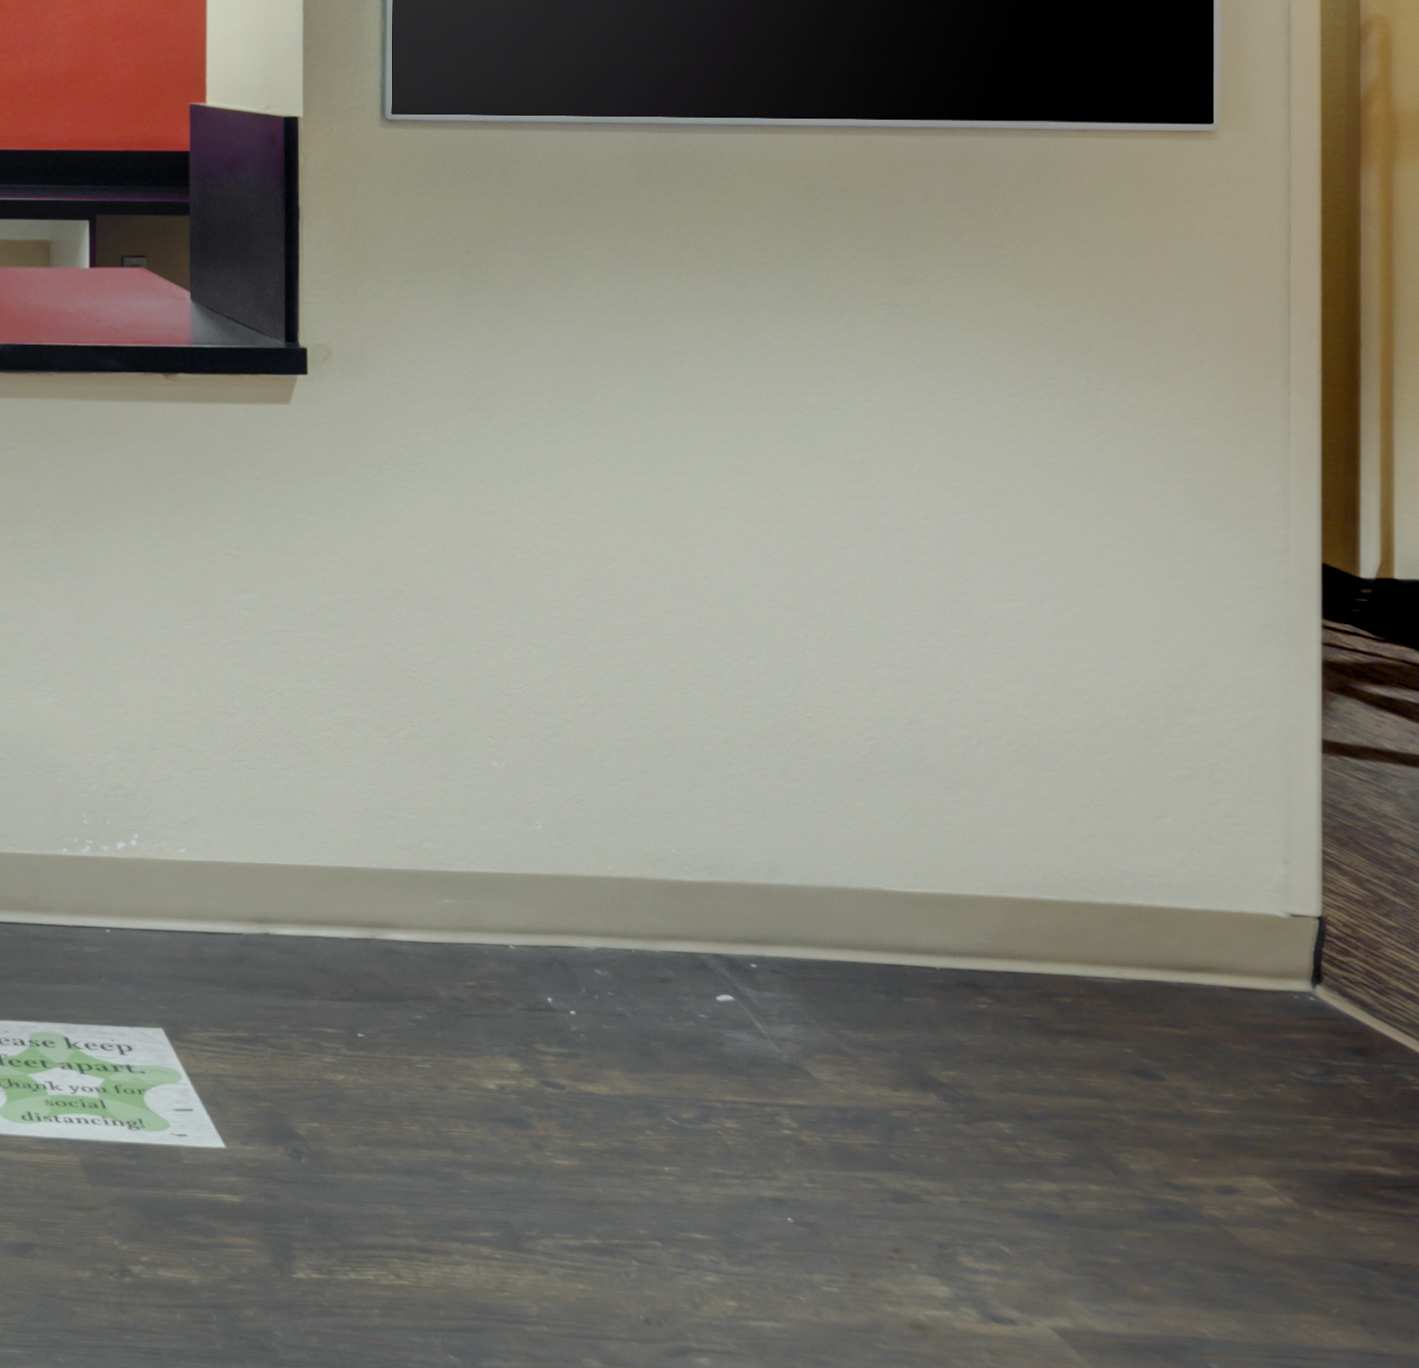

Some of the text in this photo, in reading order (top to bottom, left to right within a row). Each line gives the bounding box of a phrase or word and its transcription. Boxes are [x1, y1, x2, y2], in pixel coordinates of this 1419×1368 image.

[65, 1036, 133, 1056] keep
[58, 1060, 146, 1075] apart.
[69, 1082, 108, 1096] you
[113, 1084, 147, 1095] for
[44, 1097, 106, 1110] social
[21, 1111, 145, 1129] distancing!
